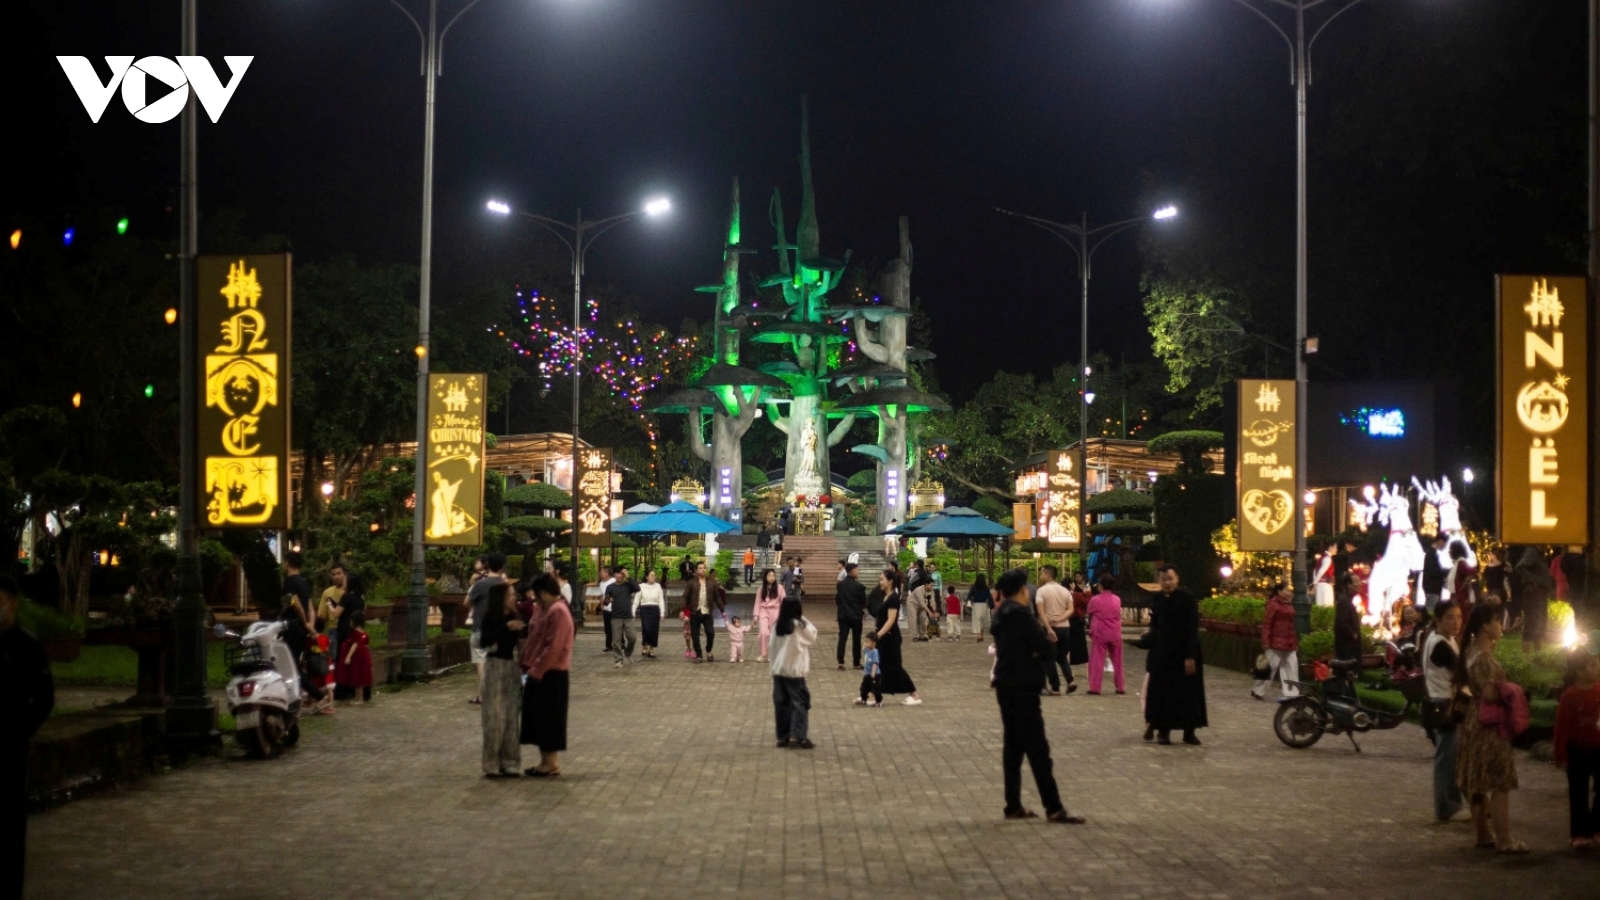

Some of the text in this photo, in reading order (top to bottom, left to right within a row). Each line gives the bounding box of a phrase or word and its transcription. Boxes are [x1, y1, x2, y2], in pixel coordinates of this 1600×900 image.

[443, 413, 470, 428] Merry
[430, 427, 482, 444] CHRISTMAS
[1243, 452, 1278, 465] Silent
